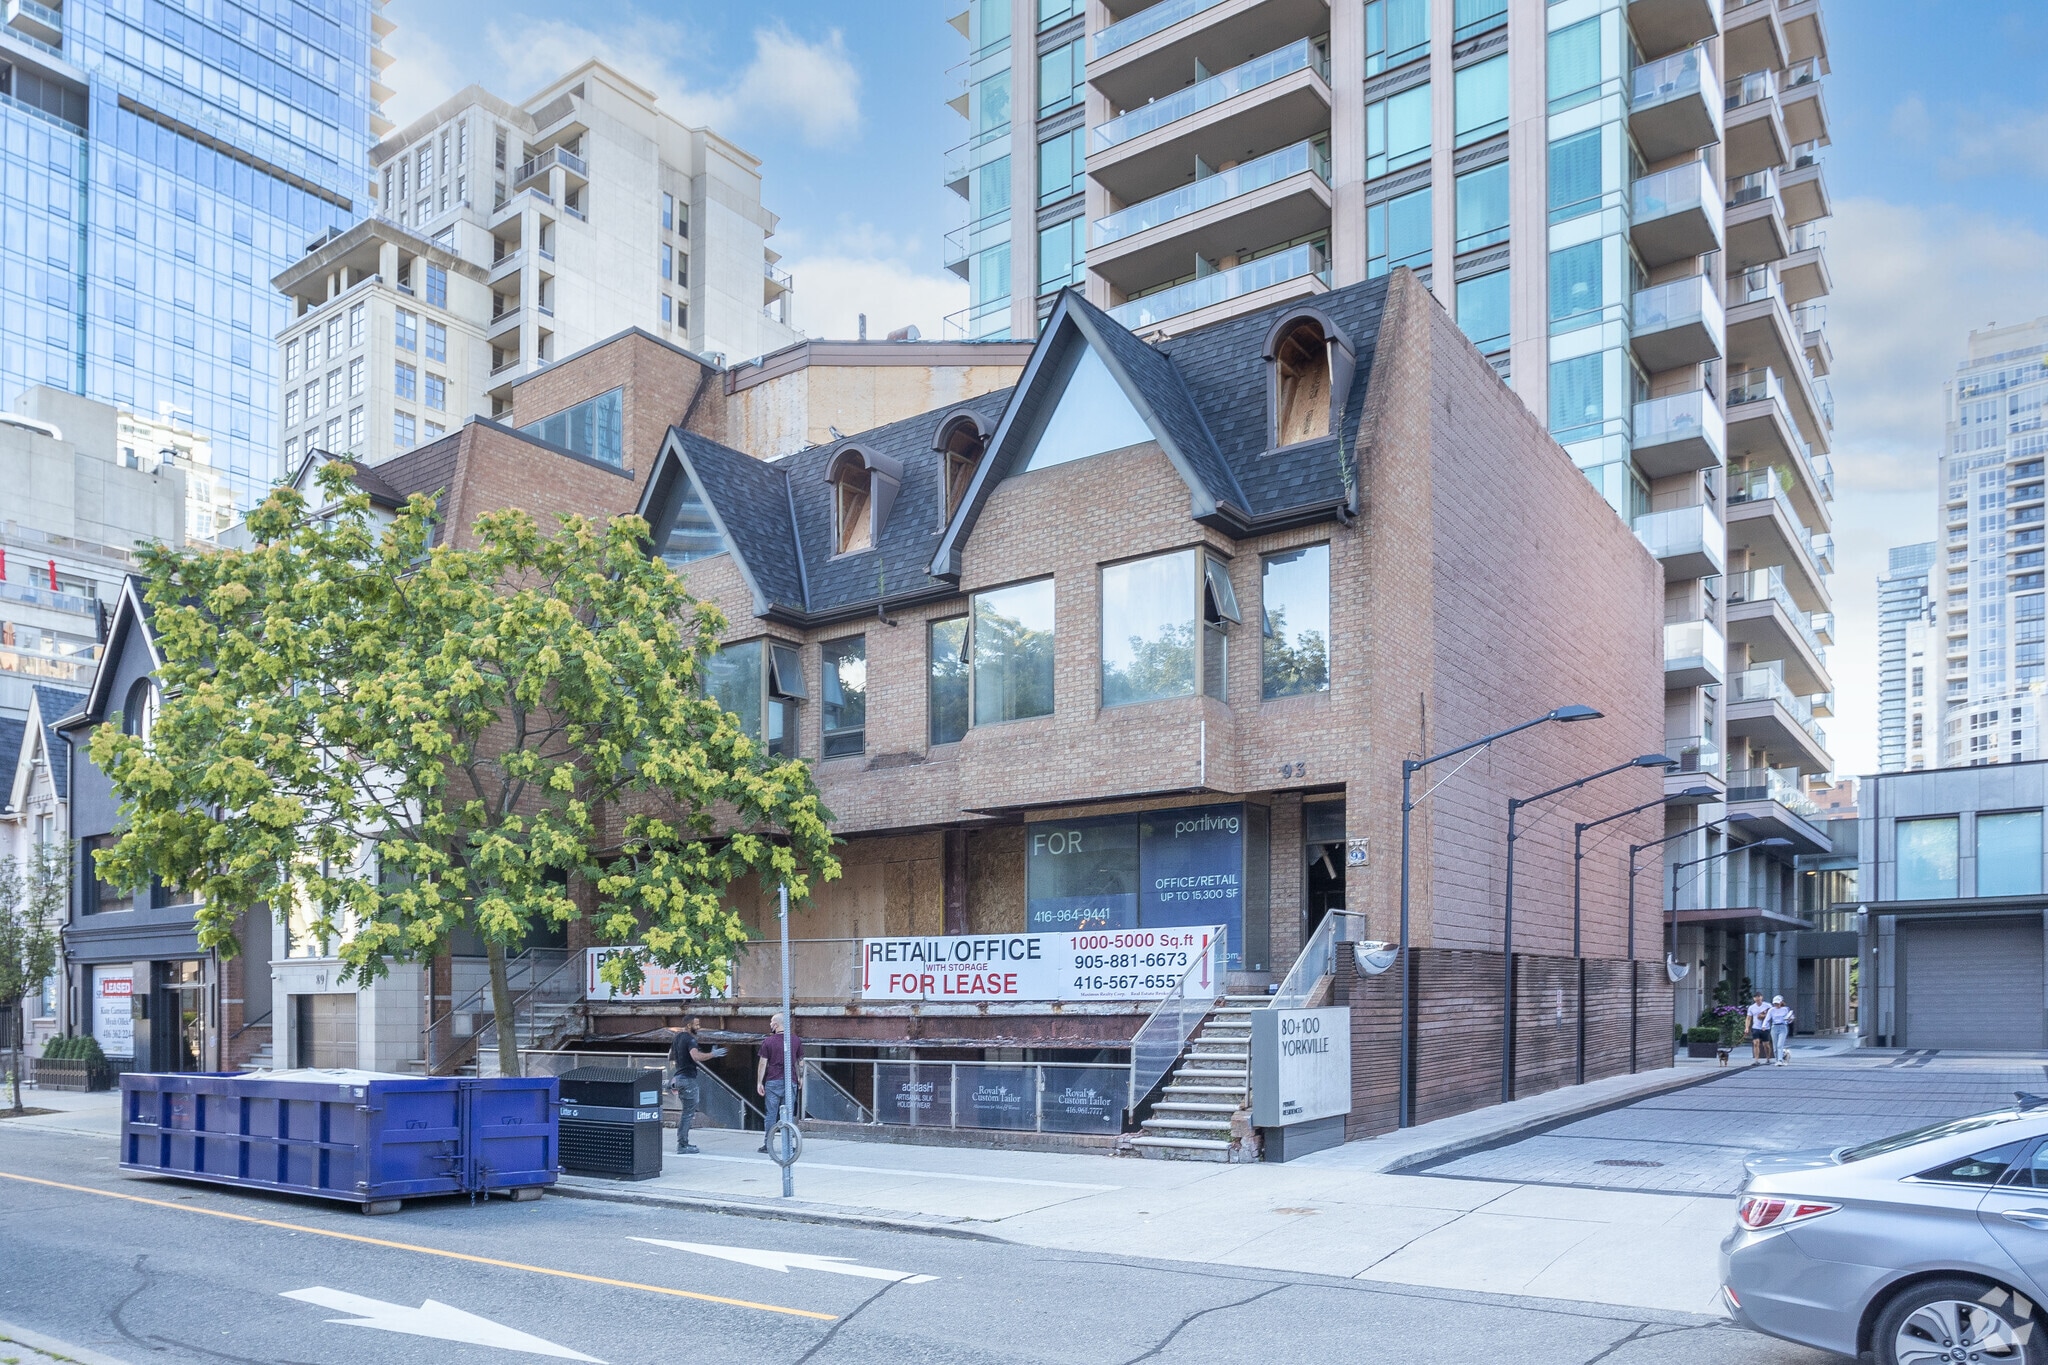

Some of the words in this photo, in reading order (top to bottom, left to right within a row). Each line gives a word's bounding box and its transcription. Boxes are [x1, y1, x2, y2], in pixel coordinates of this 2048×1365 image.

[1282, 762, 1305, 779] 93
[1175, 814, 1239, 838] portliving
[1033, 831, 1082, 856] FOR
[1350, 850, 1366, 861] 93
[1155, 874, 1239, 889] OFFICE/RETAIL
[1160, 892, 1175, 902] UP
[1177, 891, 1190, 901] TO
[1192, 890, 1223, 900] 15,300
[1226, 888, 1239, 898] SF
[1033, 908, 1110, 923] 416-964-9441
[1070, 933, 1154, 950] 1000-5000
[1159, 934, 1194, 948] Sq.ft
[870, 938, 1041, 962] RETAIL/OFFICE
[948, 963, 988, 971] STORAGE
[1075, 952, 1187, 969] 905-881-6673
[316, 974, 324, 985] 89
[650, 975, 701, 995] LEAS
[889, 973, 935, 994] FOR
[943, 973, 1018, 994] LEASE
[104, 982, 131, 993] LEASED
[1282, 1018, 1320, 1035] 80+100
[1282, 1037, 1329, 1056] YORKVILLE
[972, 1092, 999, 1101] Custom
[1001, 1093, 1021, 1102] Tailor
[979, 1086, 998, 1095] Royal
[1065, 1088, 1087, 1098] Royal
[1058, 1095, 1087, 1104] Custom
[1089, 1096, 1111, 1106] Tailor
[560, 1107, 571, 1116] Litter
[637, 1112, 651, 1120] Litter
[1066, 1106, 1103, 1115] 416.961.7777
